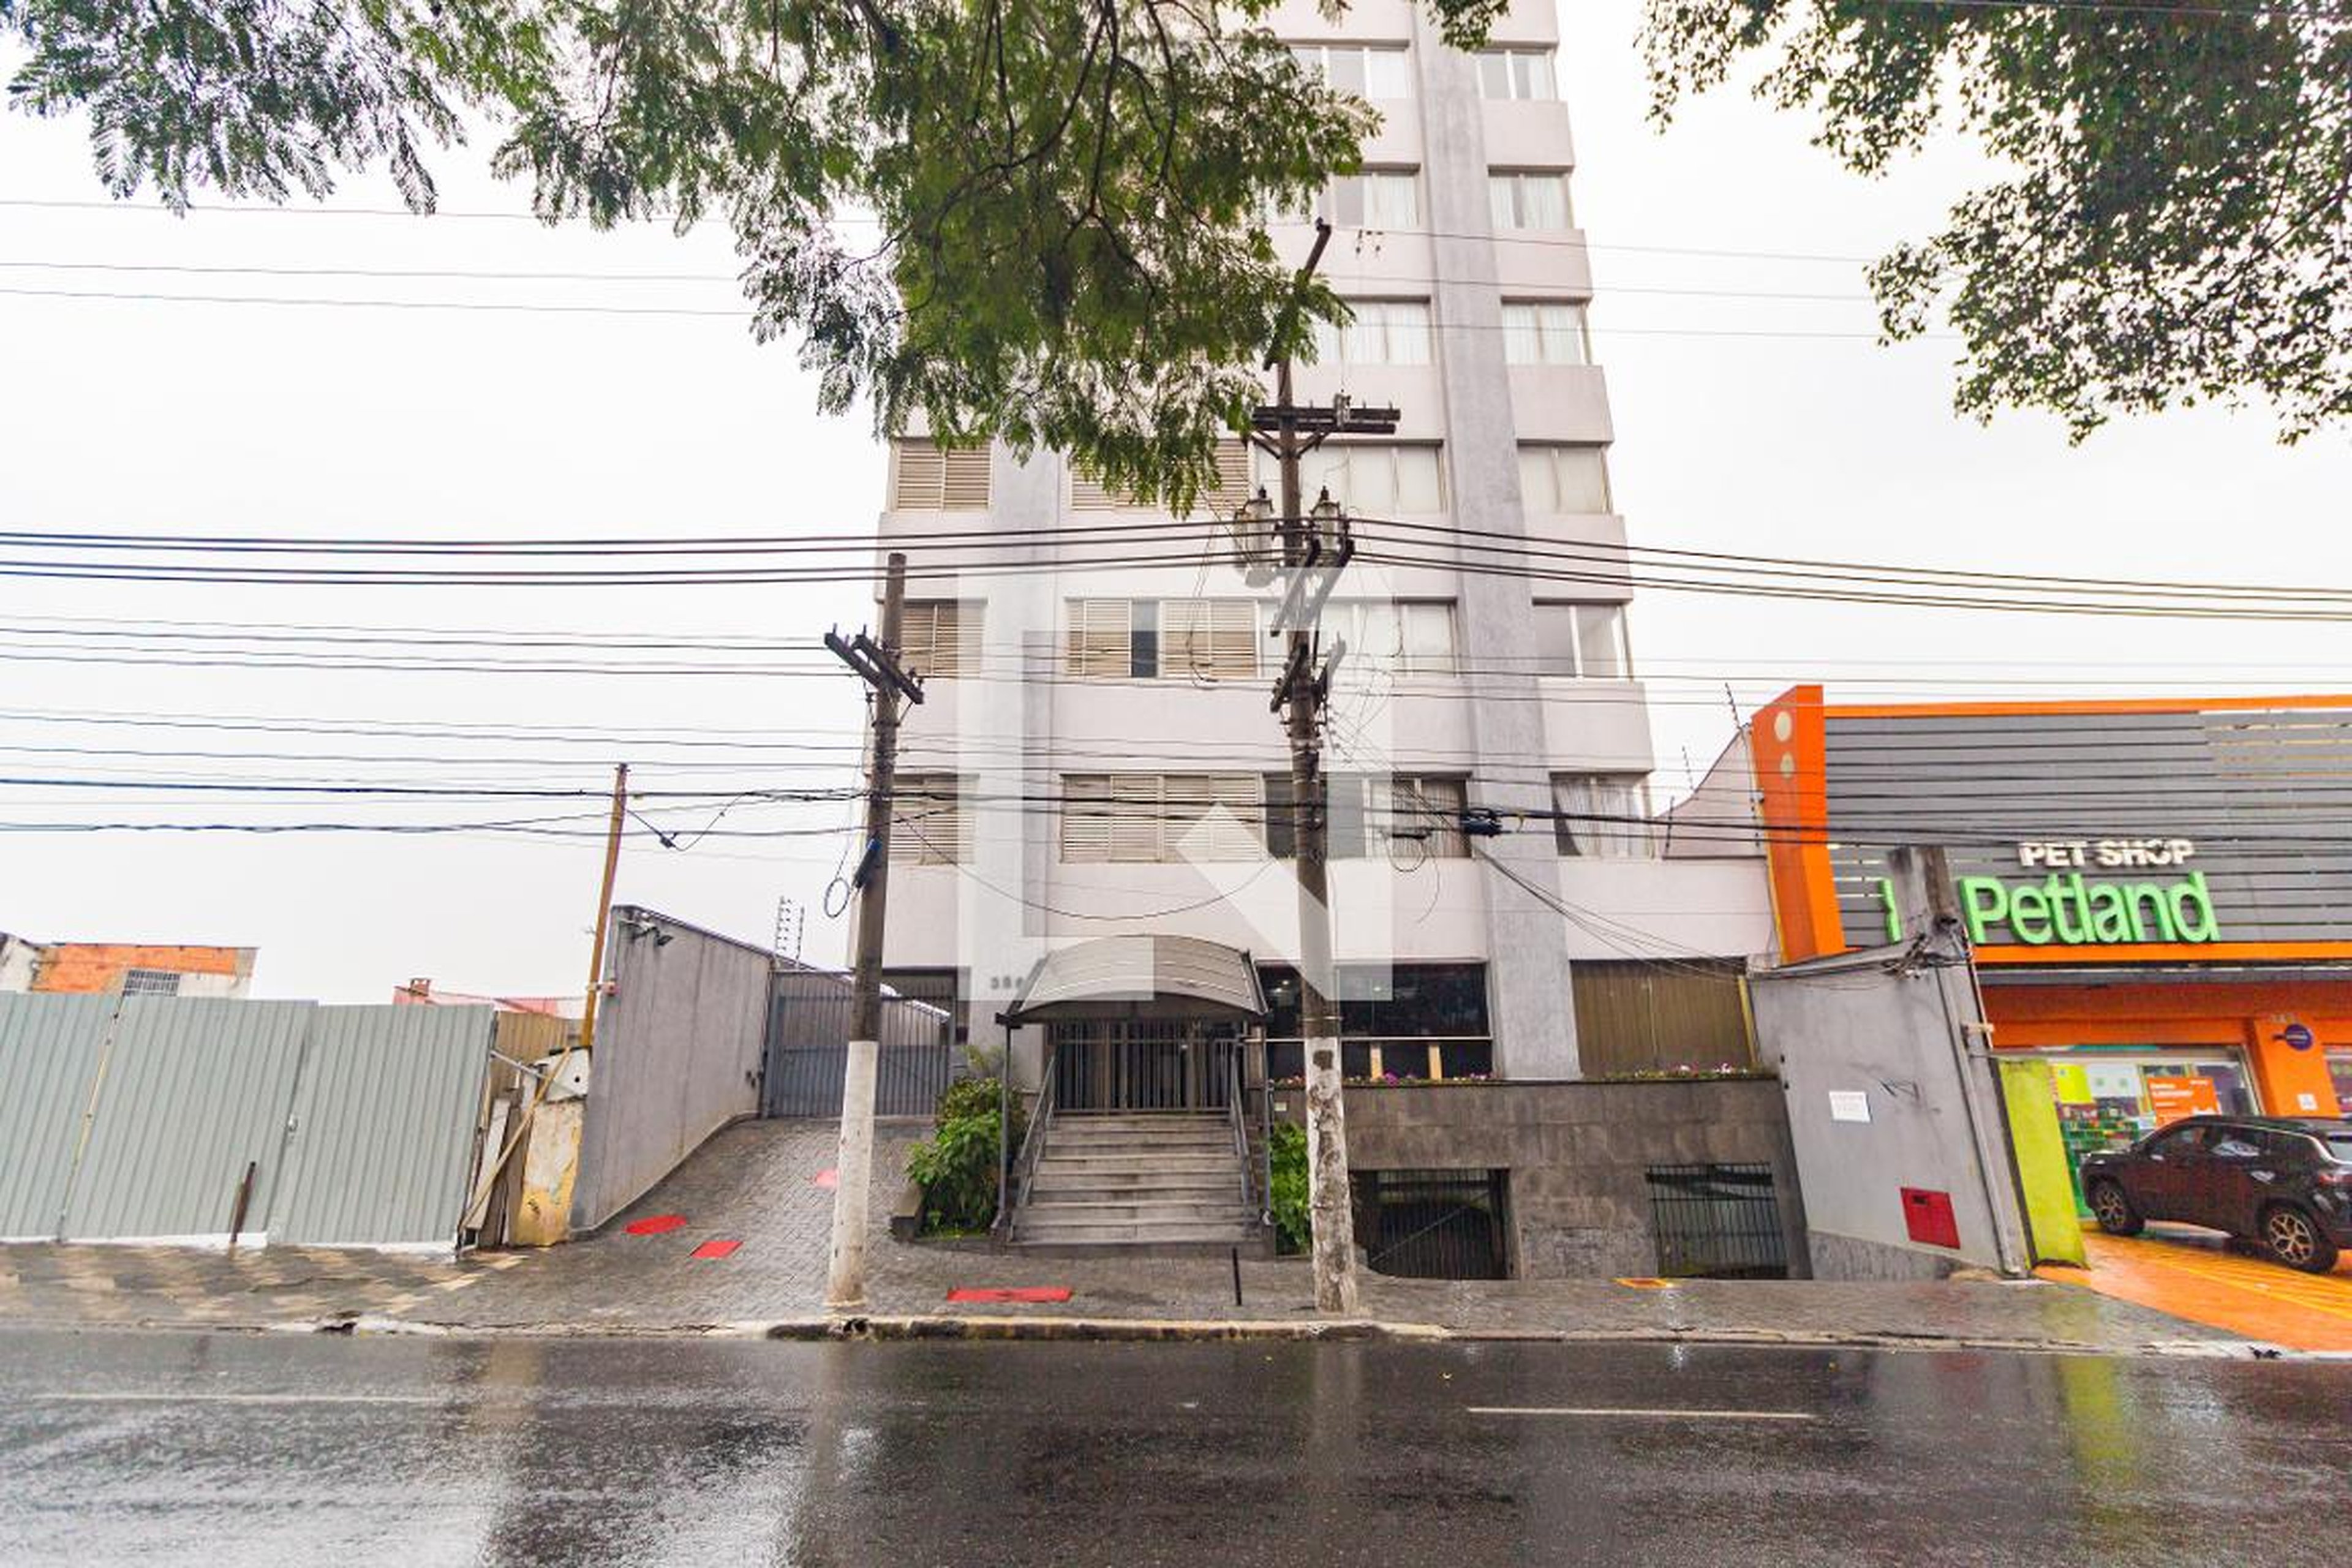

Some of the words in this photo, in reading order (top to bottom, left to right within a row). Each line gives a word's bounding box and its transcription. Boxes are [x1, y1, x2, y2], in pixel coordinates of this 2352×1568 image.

[2019, 842, 2087, 867] PET
[2095, 840, 2193, 866] SHOP
[1961, 870, 2221, 944] Petland
